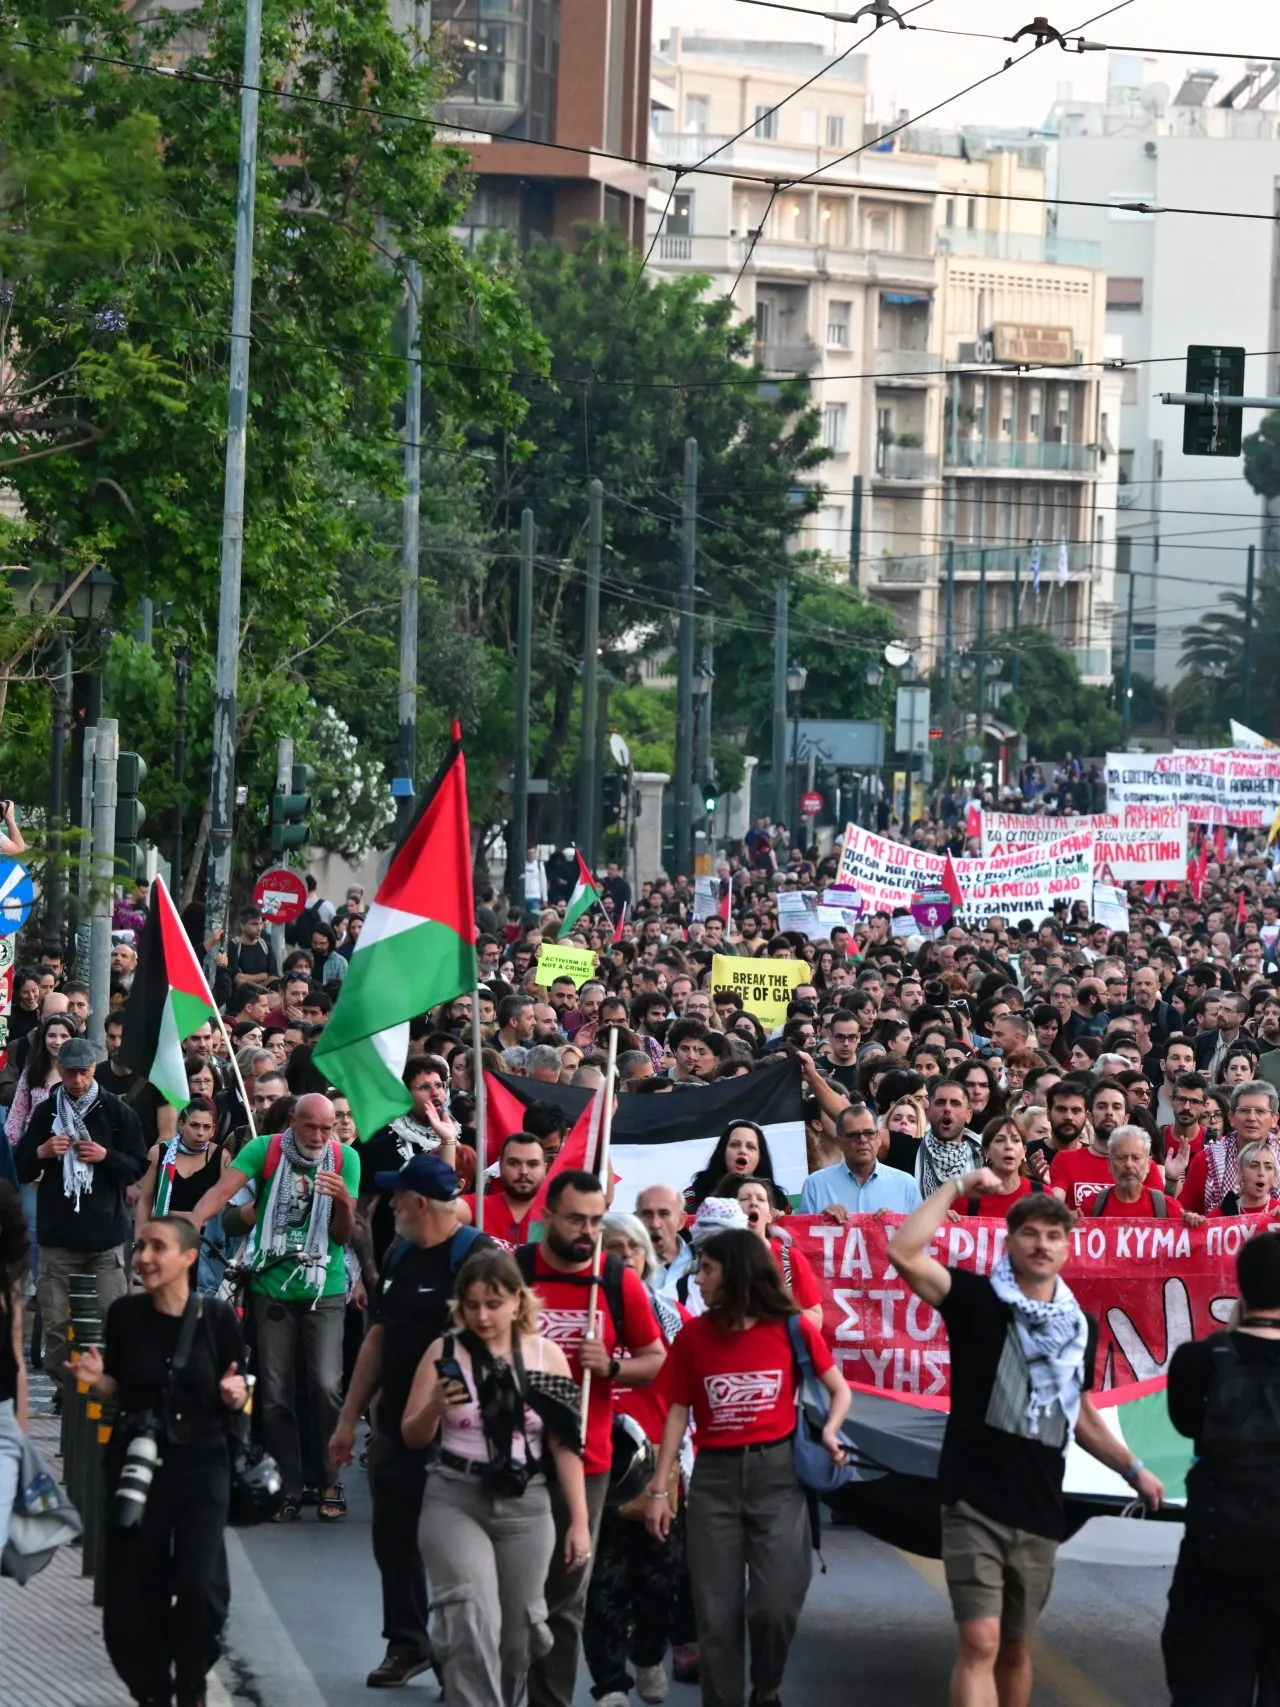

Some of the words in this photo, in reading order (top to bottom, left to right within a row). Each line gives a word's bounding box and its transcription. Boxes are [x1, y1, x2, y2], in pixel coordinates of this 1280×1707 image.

[847, 827, 859, 849] Η
[544, 956, 579, 965] ACTIVISM
[732, 972, 766, 986] BREAK
[767, 974, 788, 987] THE
[753, 987, 769, 1001] OF
[809, 1225, 873, 1279] ΤΑ
[1116, 1226, 1191, 1258] ΚΥΜΑ
